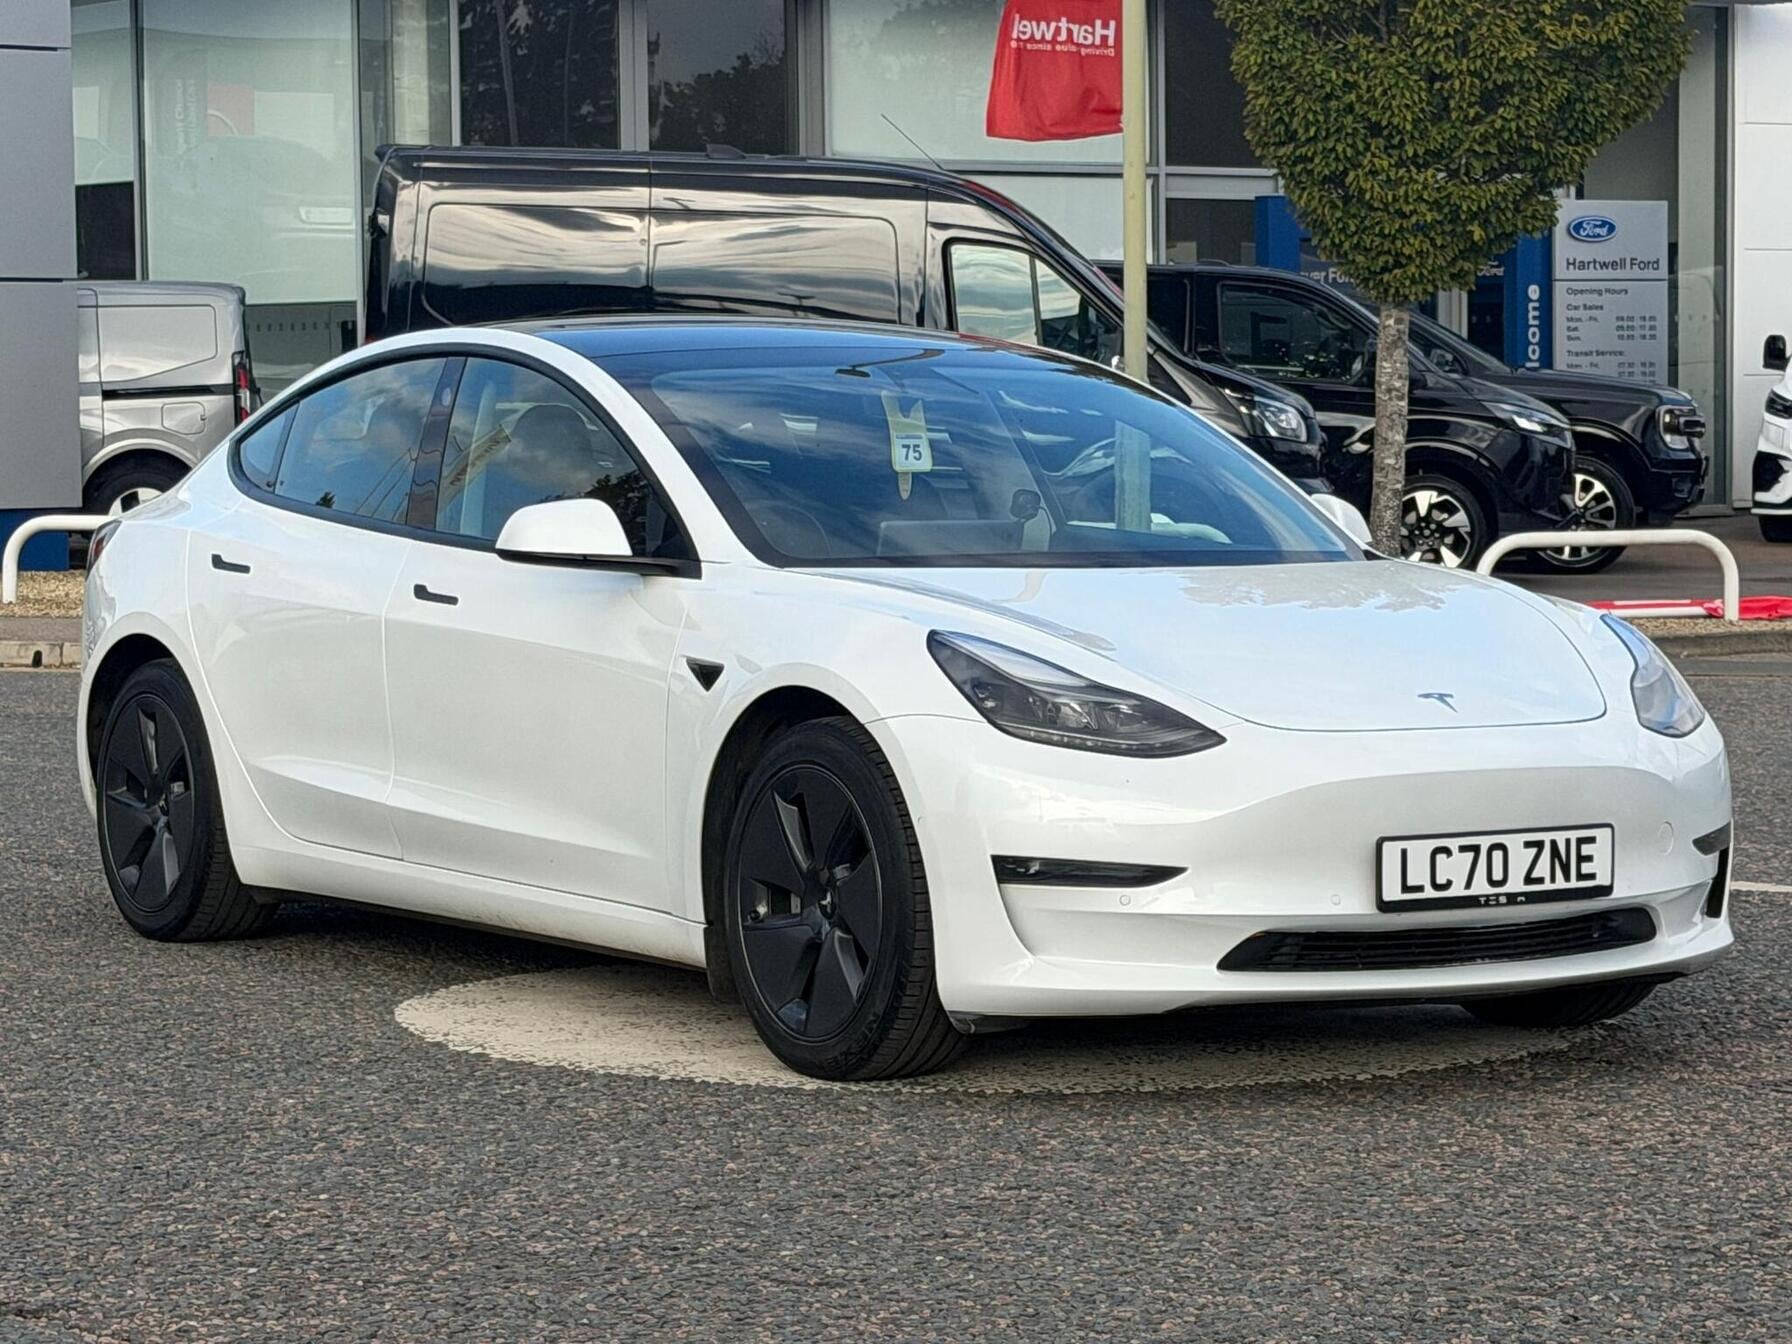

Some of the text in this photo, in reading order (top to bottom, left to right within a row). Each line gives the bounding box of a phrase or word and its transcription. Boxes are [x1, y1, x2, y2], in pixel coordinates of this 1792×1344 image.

[1579, 220, 1610, 237] Ford
[1566, 257, 1660, 271] Hartwell Ford
[1566, 287, 1629, 297] Opening Hours
[1566, 303, 1604, 311] Car Sales
[901, 443, 922, 462] 75
[1400, 835, 1598, 895] LC70 ZNE
[1478, 895, 1527, 905] TESA
